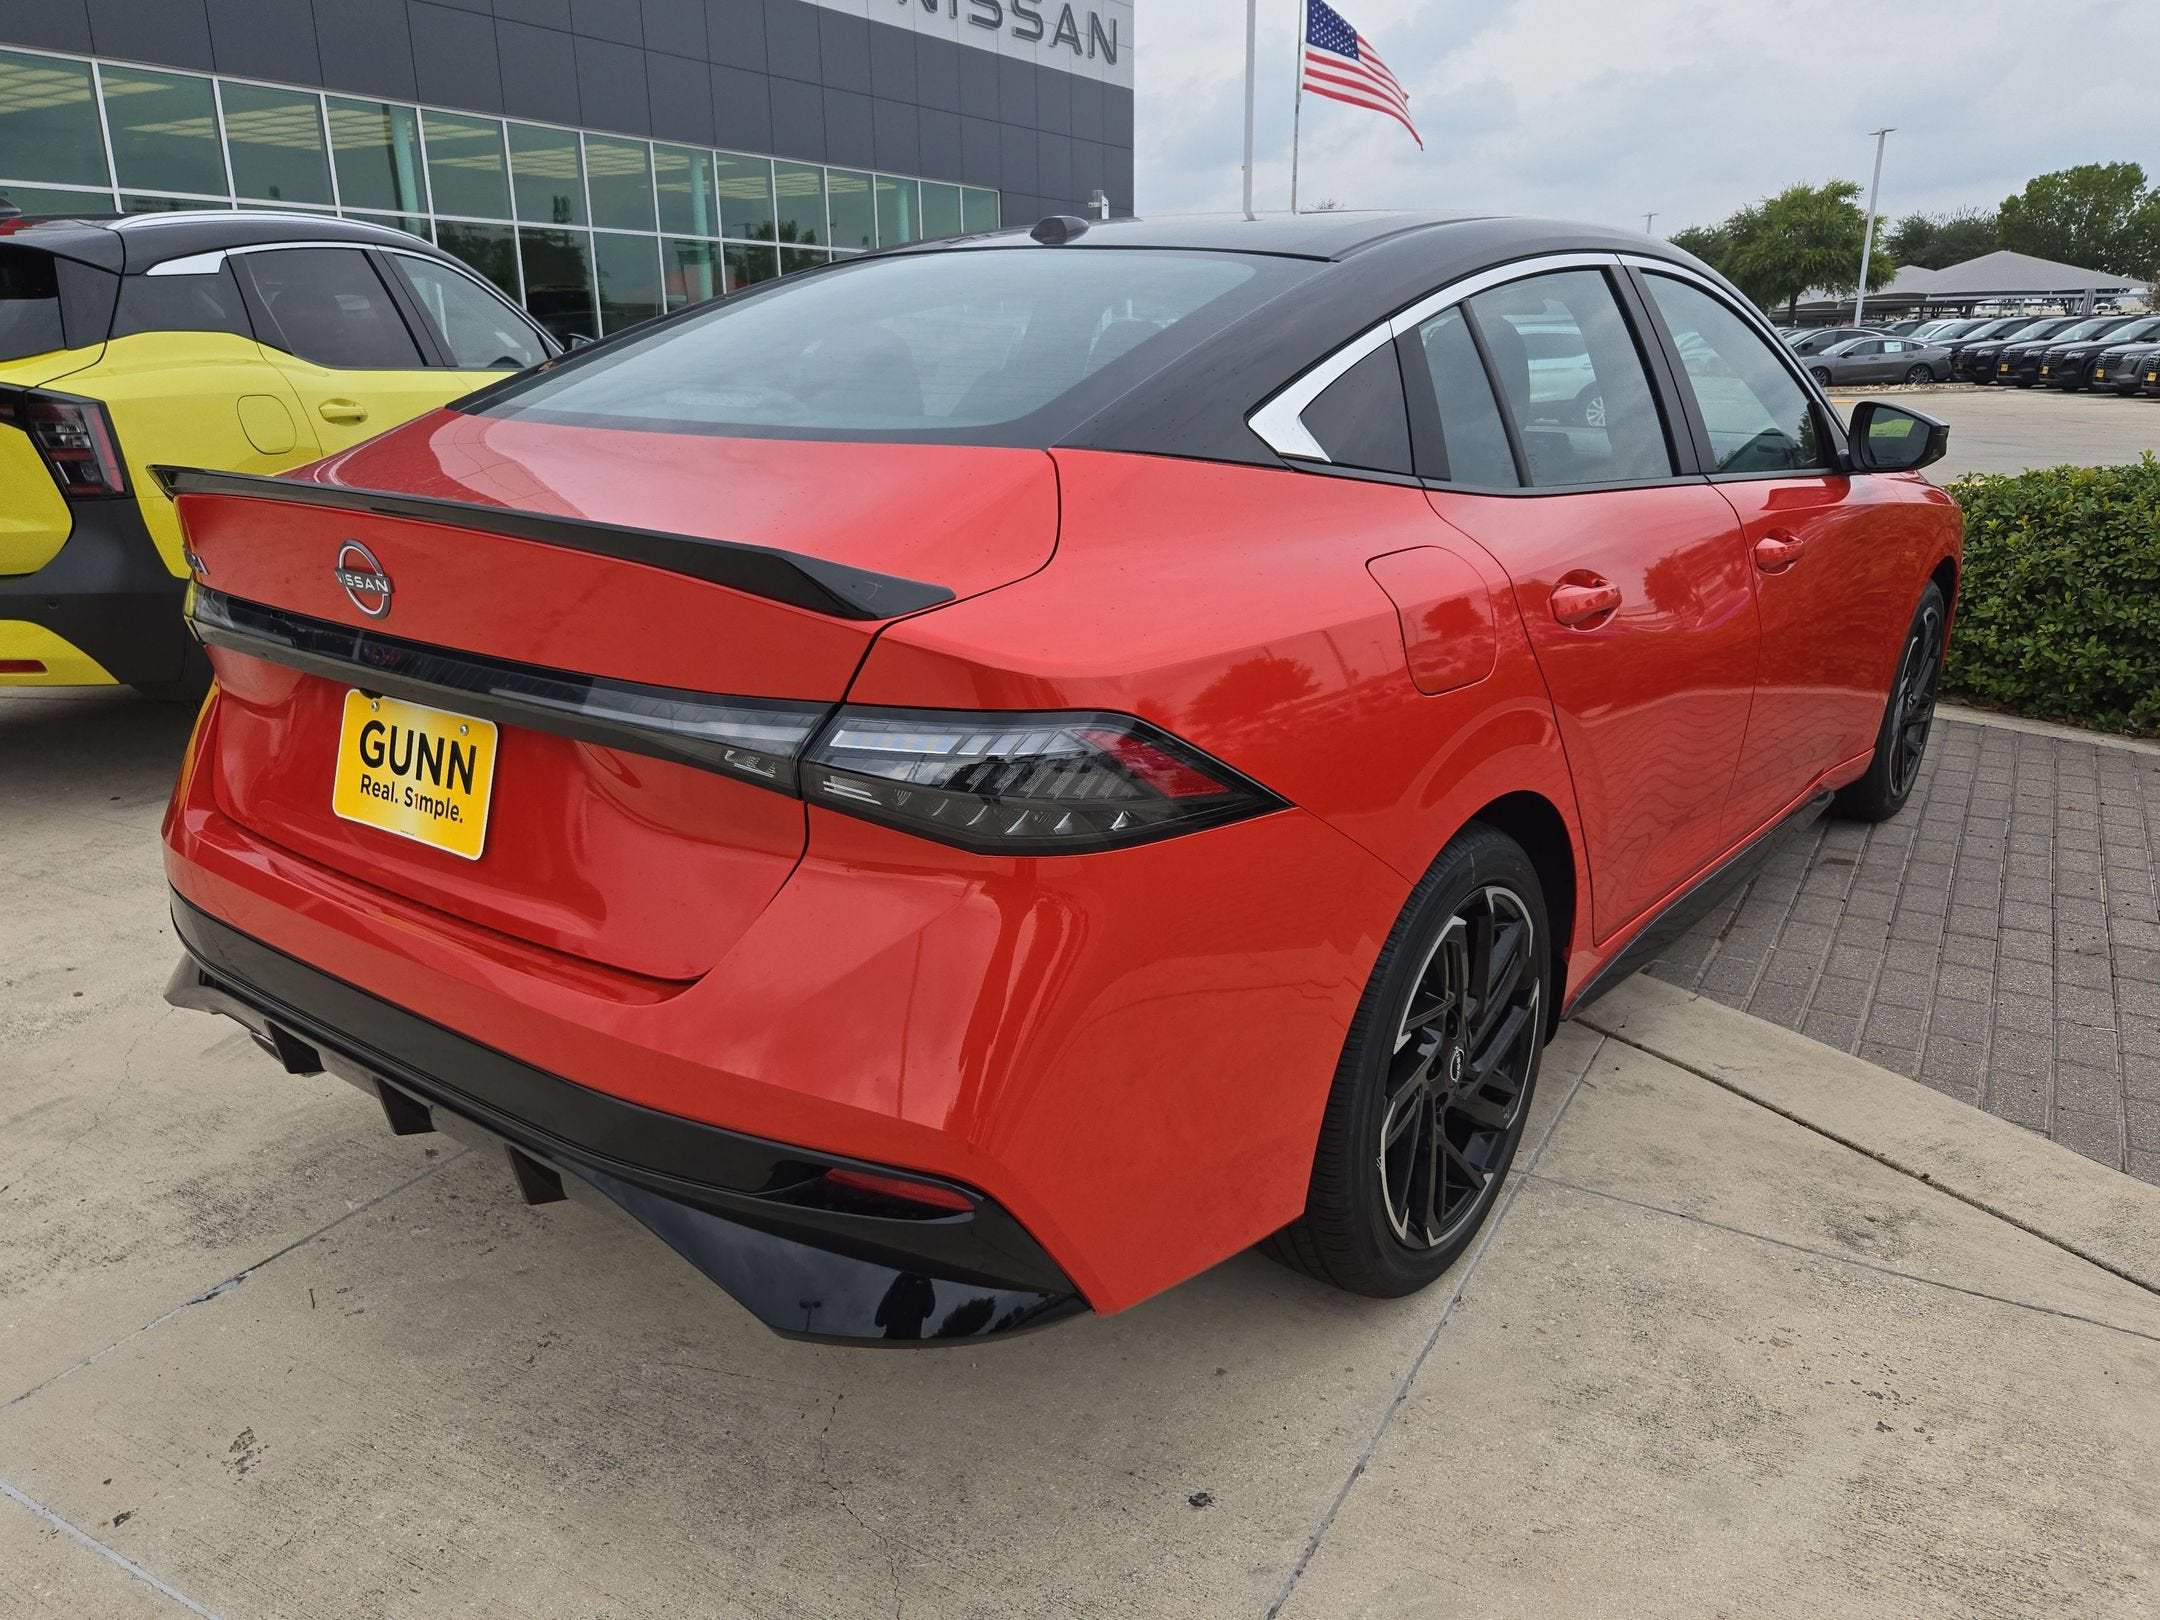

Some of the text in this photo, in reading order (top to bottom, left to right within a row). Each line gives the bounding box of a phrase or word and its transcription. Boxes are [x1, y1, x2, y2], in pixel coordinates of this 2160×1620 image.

[897, 0, 1117, 65] SSAN
[360, 720, 477, 795] GUNN
[360, 773, 463, 823] Real. S1mple.
